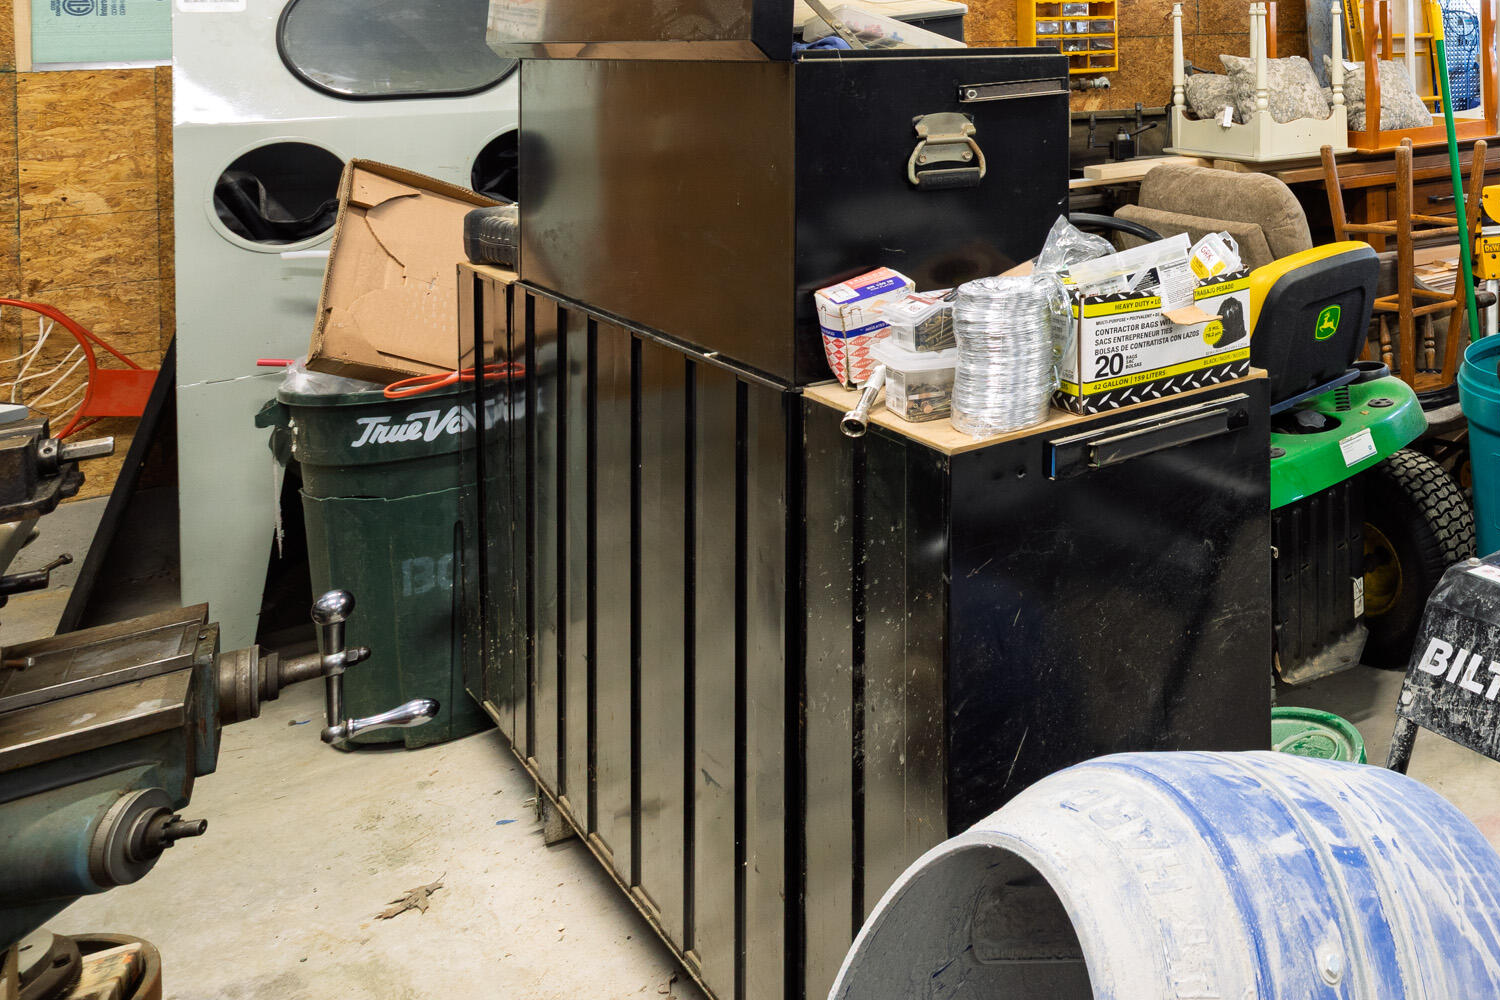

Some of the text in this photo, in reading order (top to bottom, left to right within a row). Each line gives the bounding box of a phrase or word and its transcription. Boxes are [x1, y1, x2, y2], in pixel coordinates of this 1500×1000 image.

[1114, 303, 1133, 311] HEAVY
[1135, 300, 1149, 308] DUTY
[1094, 327, 1173, 346] SACS ENTREPRENEUR TIES
[1095, 324, 1140, 337] CONTRACTOR
[1140, 321, 1158, 330] BAGS
[1094, 330, 1200, 356] BOLSAS DE CONTRATISTA CON LAZOS
[1094, 353, 1124, 379] 20
[1102, 377, 1130, 389] GALLON
[1134, 374, 1145, 382] 159
[1145, 370, 1166, 381] LITERS
